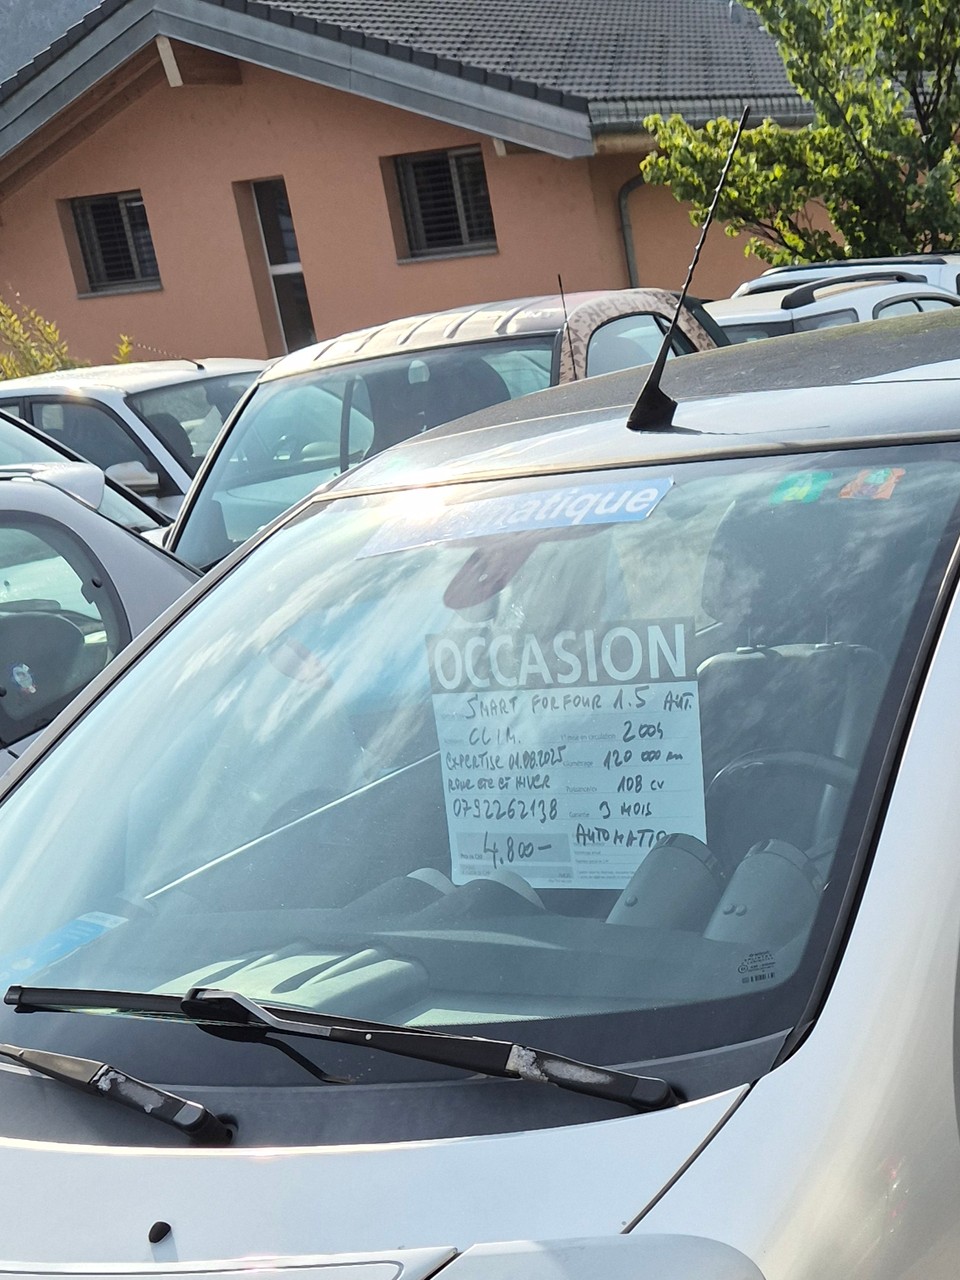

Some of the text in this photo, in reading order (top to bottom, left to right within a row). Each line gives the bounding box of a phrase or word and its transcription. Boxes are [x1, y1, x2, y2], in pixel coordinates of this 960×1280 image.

[433, 623, 688, 691] OCCASION
[465, 694, 518, 719] SMART
[531, 692, 602, 714] FORFOUR
[613, 685, 650, 710] 1.5
[469, 726, 521, 746] CLIM.
[622, 720, 664, 743] 2004
[603, 749, 633, 771] 120
[617, 774, 643, 794] 108
[453, 798, 558, 824] 0792262138
[620, 801, 652, 817] MOIS
